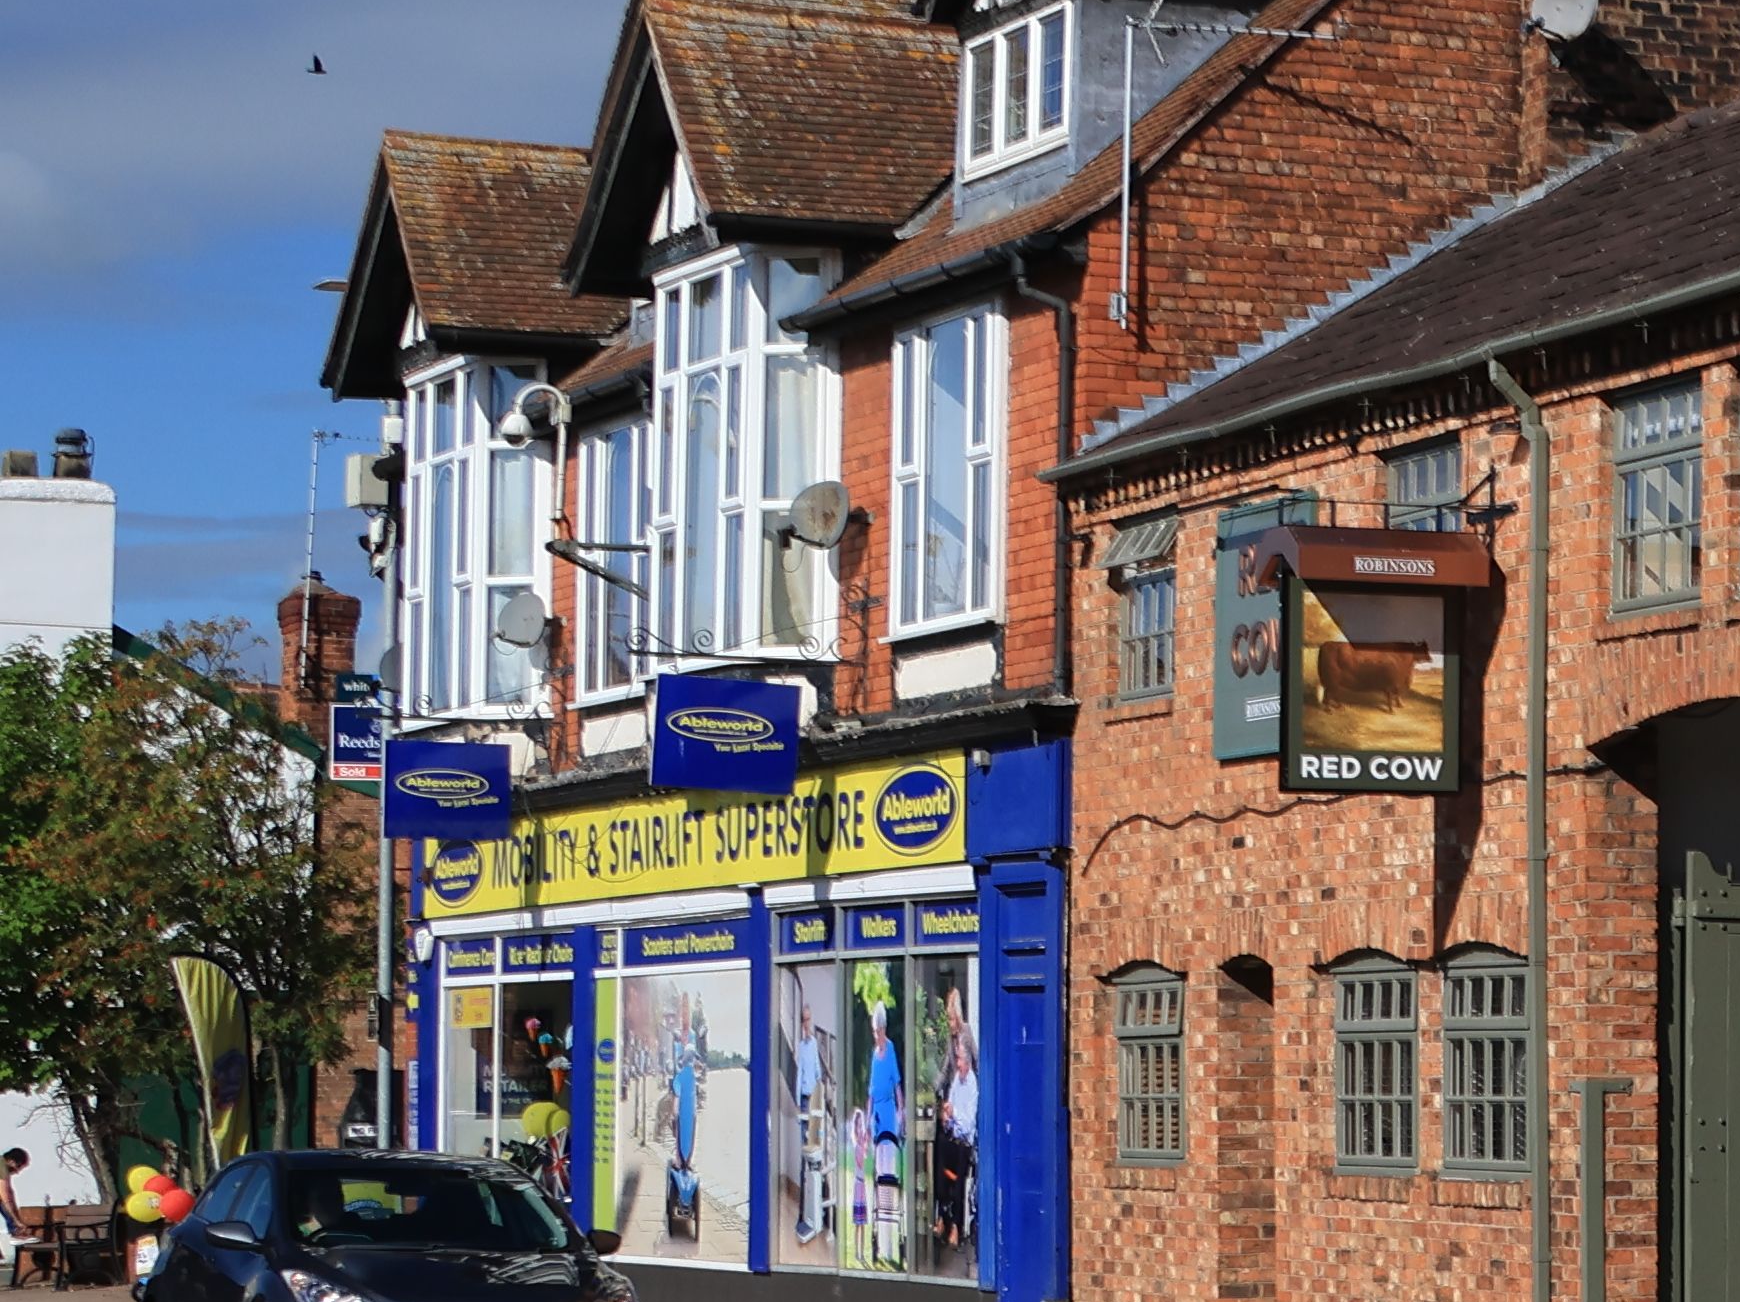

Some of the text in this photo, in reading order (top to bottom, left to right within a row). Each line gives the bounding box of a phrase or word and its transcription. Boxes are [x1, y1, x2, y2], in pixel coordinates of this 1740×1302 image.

[1355, 558, 1436, 574] ROBINSONS
[679, 716, 764, 732] Ableworld
[339, 767, 367, 777] Sold
[1300, 755, 1444, 781] RED COW
[405, 775, 481, 789] Ableworld
[882, 786, 951, 821] Ableworld
[491, 789, 866, 889] MOBILITY & STAIRLIFT SUPERSTORE
[434, 852, 480, 881] Ableworld
[861, 914, 897, 938] Walkers
[922, 908, 980, 935] Wheelchairs
